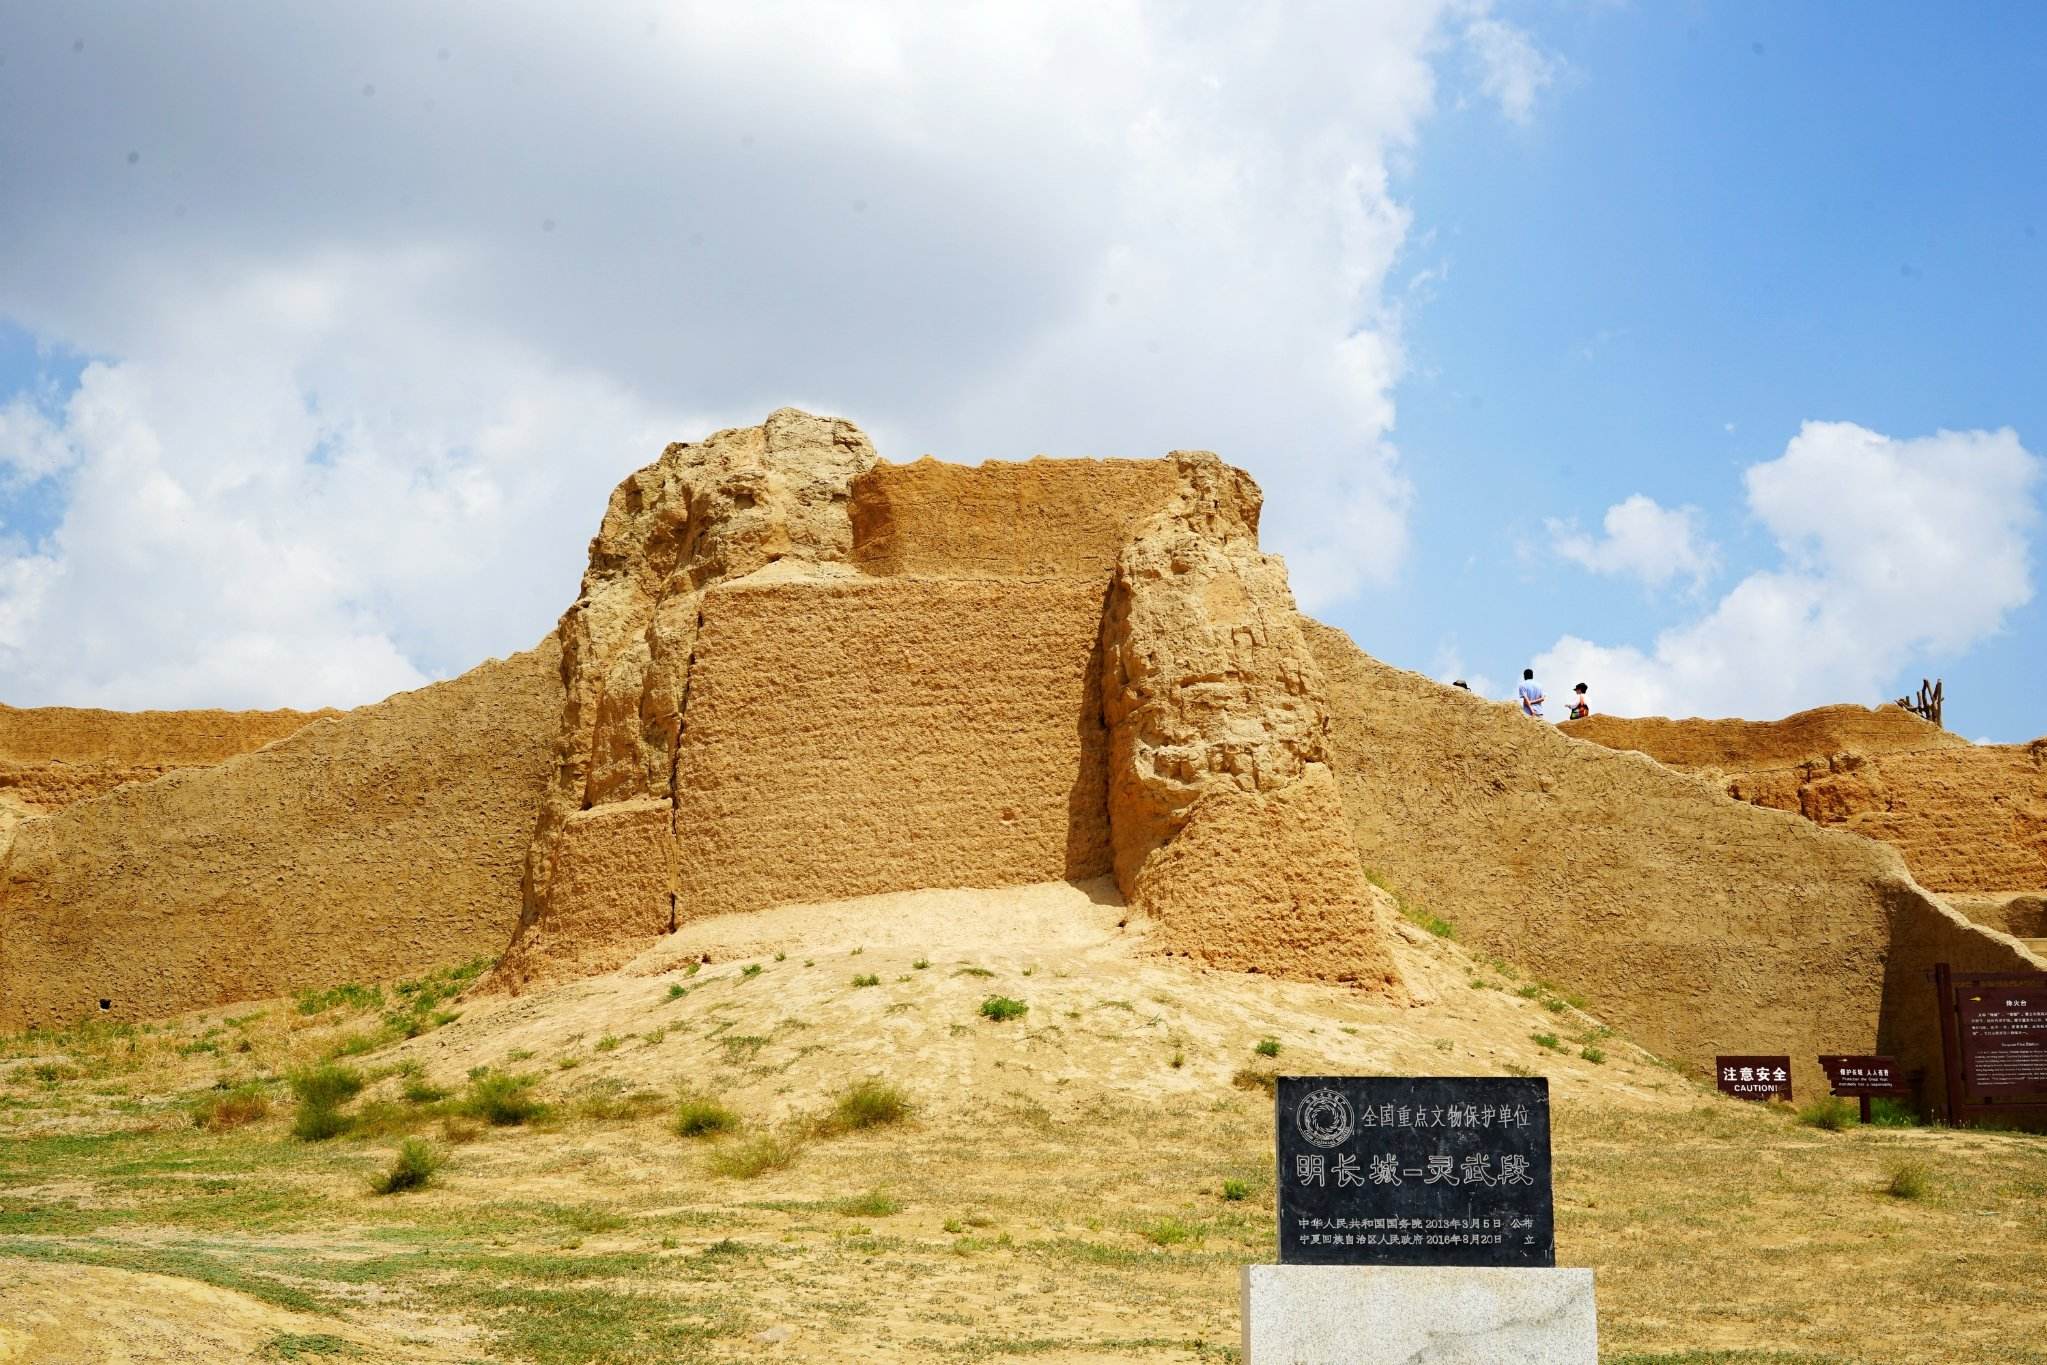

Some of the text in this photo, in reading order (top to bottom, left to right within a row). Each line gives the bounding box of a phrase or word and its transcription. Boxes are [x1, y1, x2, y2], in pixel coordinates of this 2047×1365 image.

[1723, 1067, 1787, 1082] 注意安全
[1734, 1084, 1778, 1092] CAUTION!
[1361, 1103, 1530, 1128] 全国重点文物保护单位
[1298, 1218, 1534, 1229] 中华人民共和国国务院 2013年3月5日 公布
[1299, 1234, 1536, 1245] 宁夏回族自治区人民政府 2016年8月20日 立
